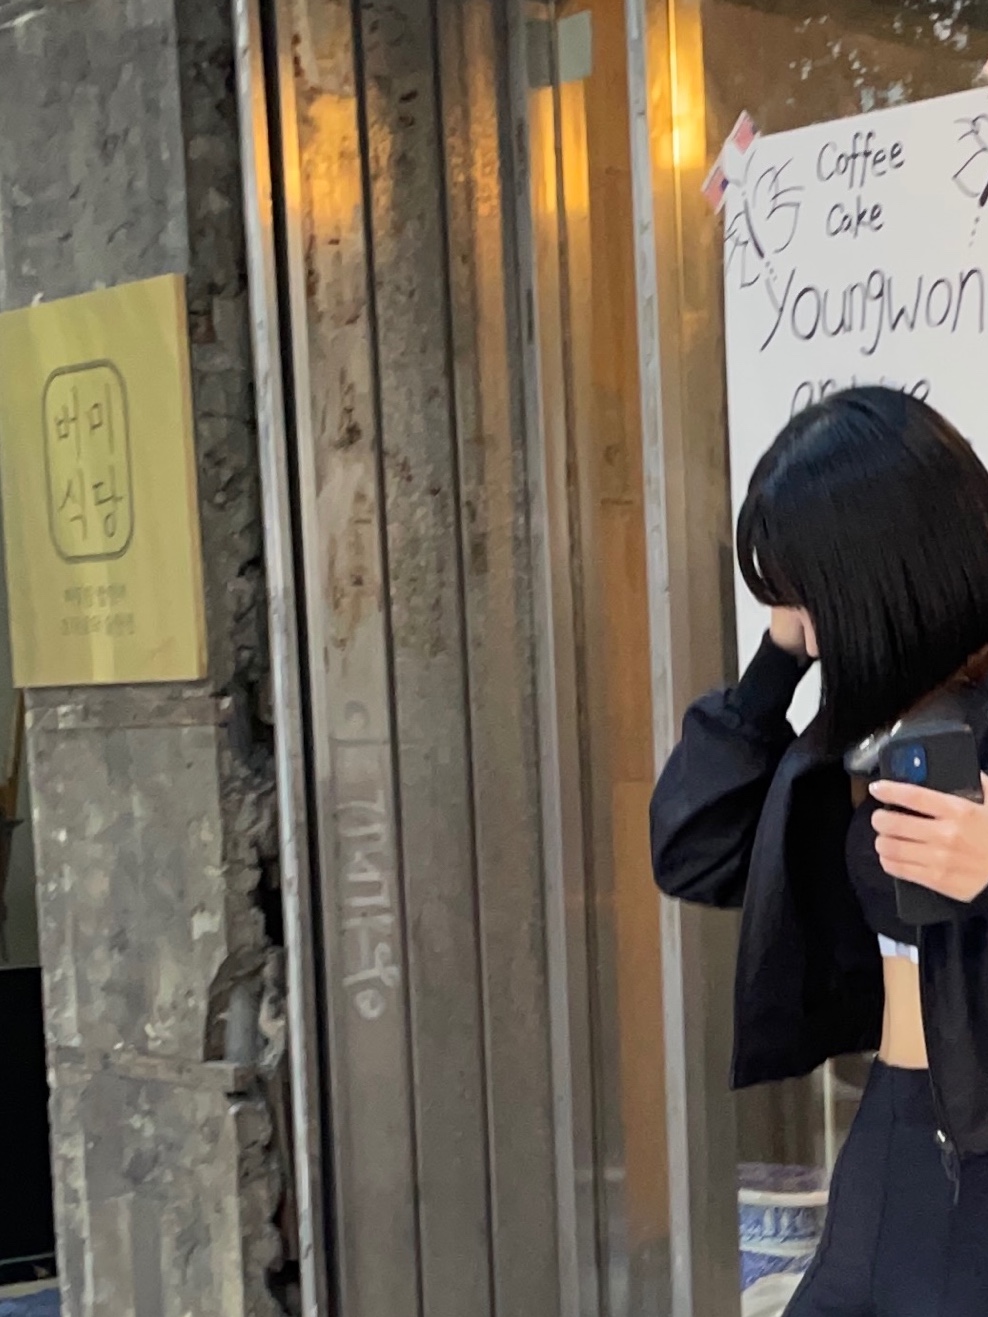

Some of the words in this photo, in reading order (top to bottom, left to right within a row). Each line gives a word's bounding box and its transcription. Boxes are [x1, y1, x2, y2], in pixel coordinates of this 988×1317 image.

[816, 131, 905, 190] Coffee
[825, 197, 885, 238] Cake
[760, 266, 985, 355] Youngwon
[58, 464, 123, 541] 식당
